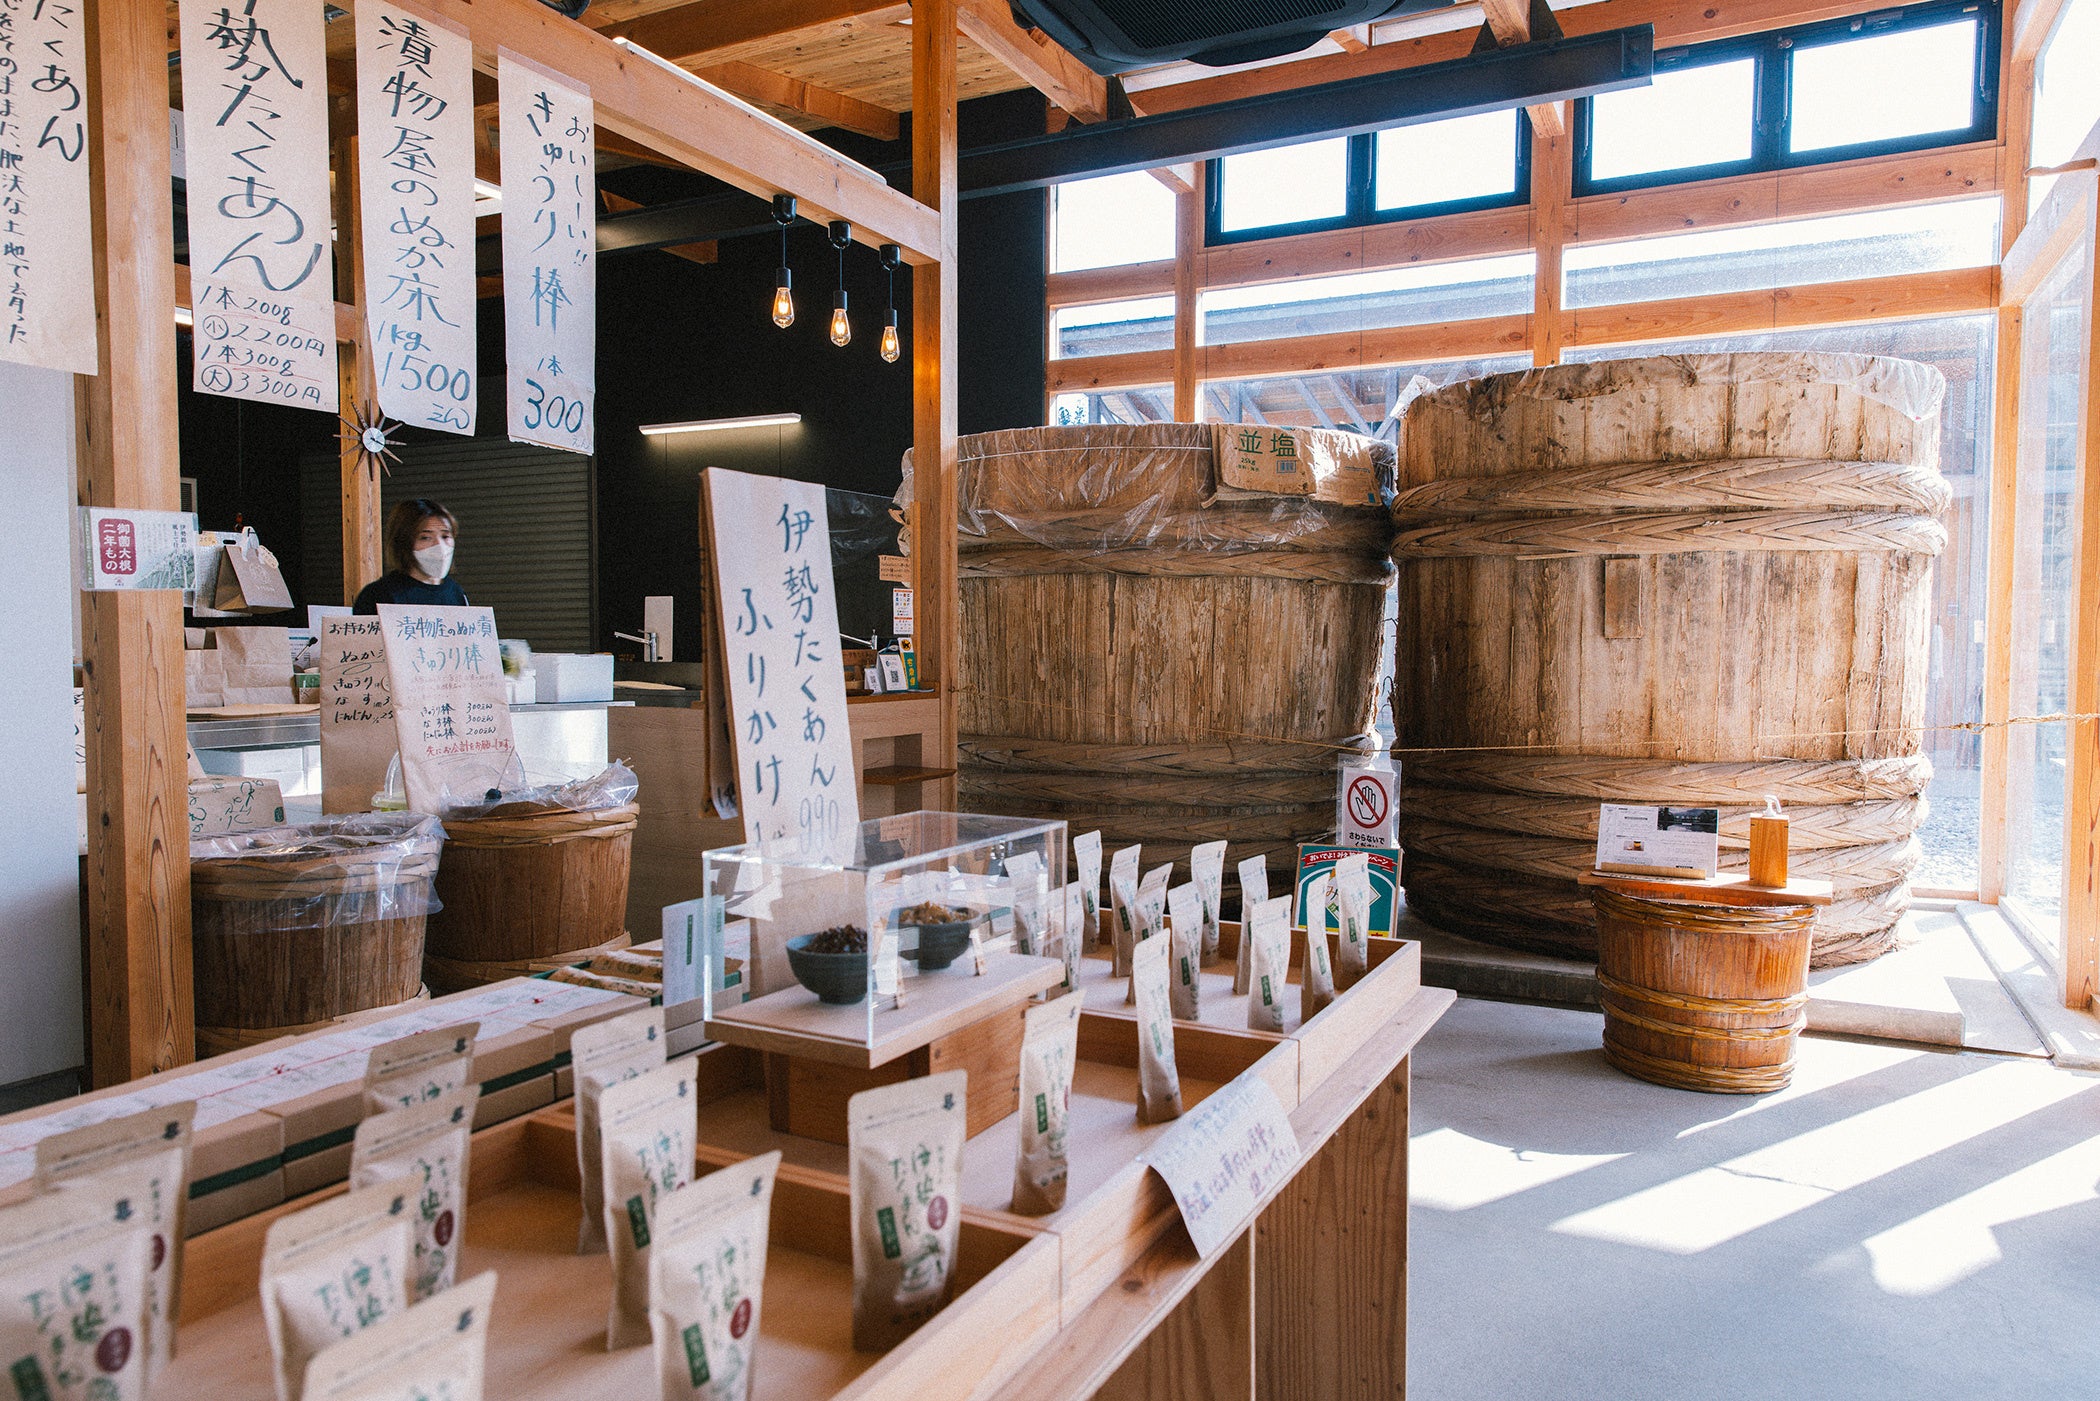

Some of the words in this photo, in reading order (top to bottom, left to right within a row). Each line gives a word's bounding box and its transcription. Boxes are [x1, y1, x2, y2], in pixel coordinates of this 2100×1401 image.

[204, 0, 323, 292] 勢たくあん
[377, 15, 461, 328] 漬物屋のぬか床
[526, 91, 572, 335] きゅうり棒
[378, 320, 431, 352] 1kg
[382, 351, 471, 402] 1500
[537, 354, 564, 377] 1本
[524, 378, 584, 434] 300
[1238, 429, 1297, 457] 並塩
[103, 523, 118, 571] 二年もの
[396, 615, 493, 641] 漬物屋のぬか漬
[776, 503, 837, 788] 伊勢たくあん
[412, 643, 488, 675] きゅうり棒
[335, 709, 372, 724] にんじん
[735, 588, 782, 806] ふりかけ
[1349, 832, 1385, 844] さわらないで
